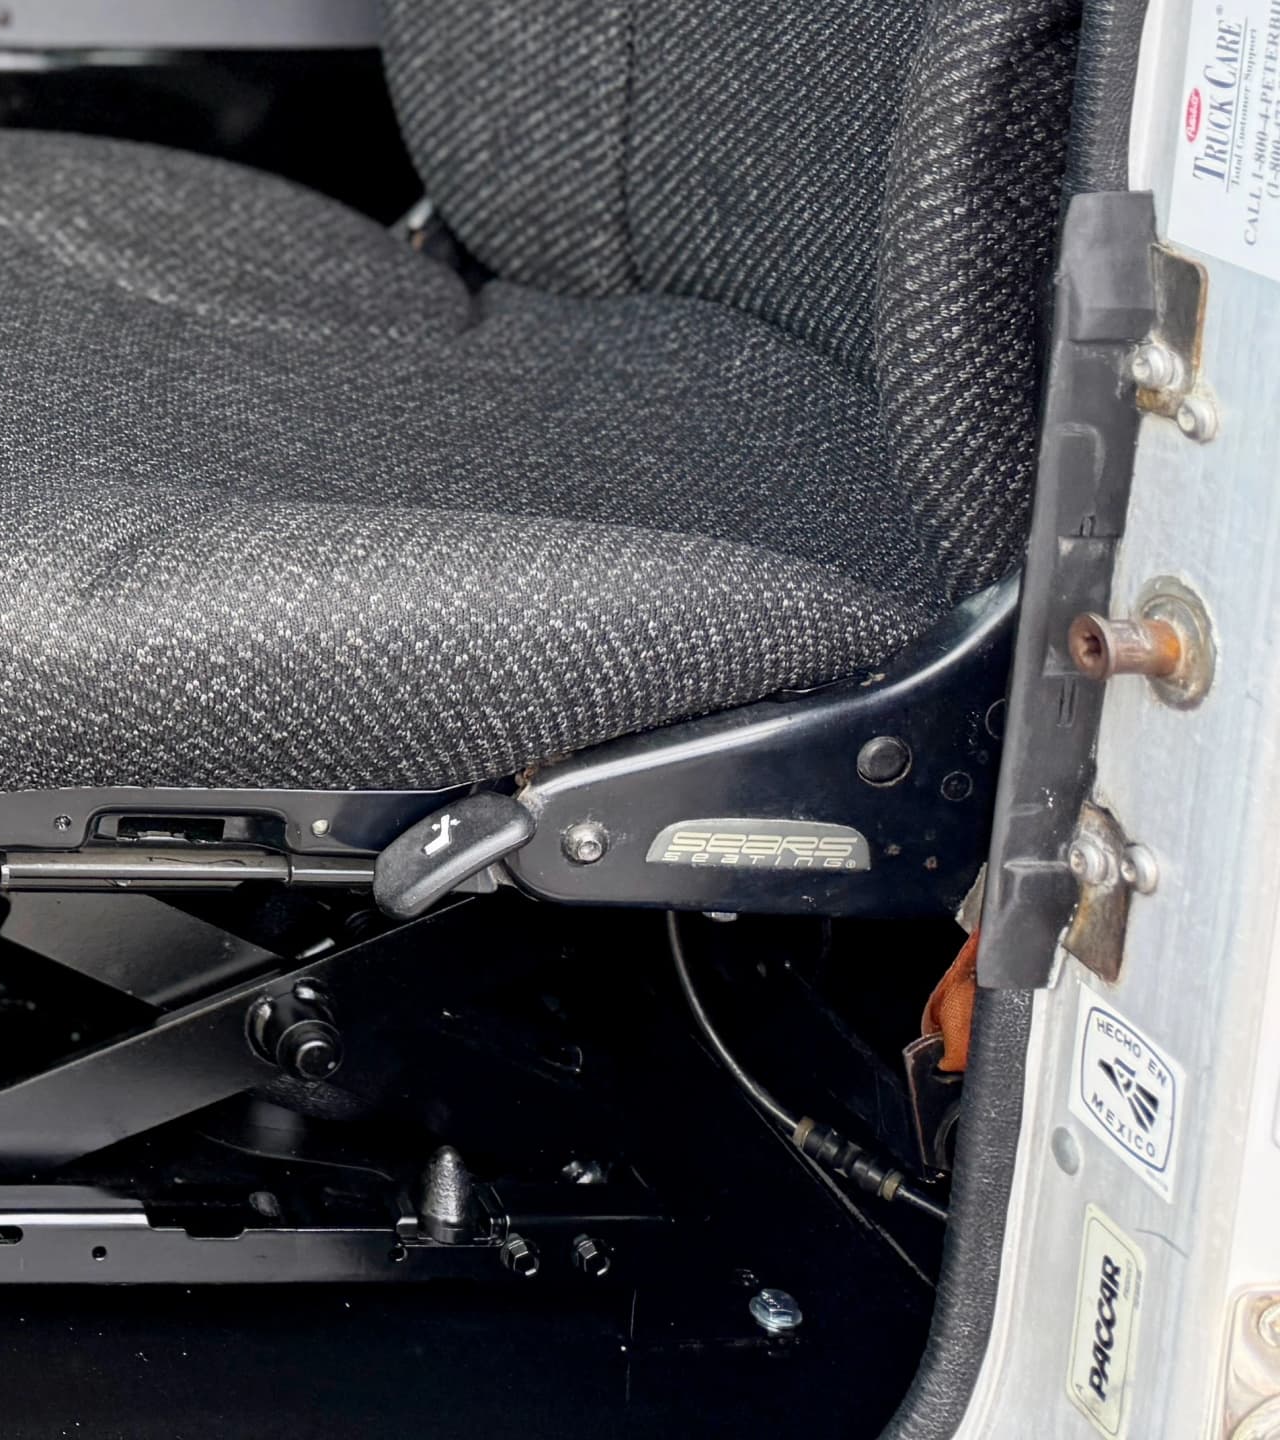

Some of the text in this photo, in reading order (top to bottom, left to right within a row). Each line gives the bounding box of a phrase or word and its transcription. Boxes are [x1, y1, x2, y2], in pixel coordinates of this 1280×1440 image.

[1192, 93, 1234, 181] TRUCK
[1244, 187, 1262, 246] CALL
[668, 831, 858, 858] SEARS
[1096, 1016, 1168, 1088] HECHO EN
[1091, 1092, 1156, 1159] MEXICO
[1088, 1254, 1123, 1403] PACCAR
